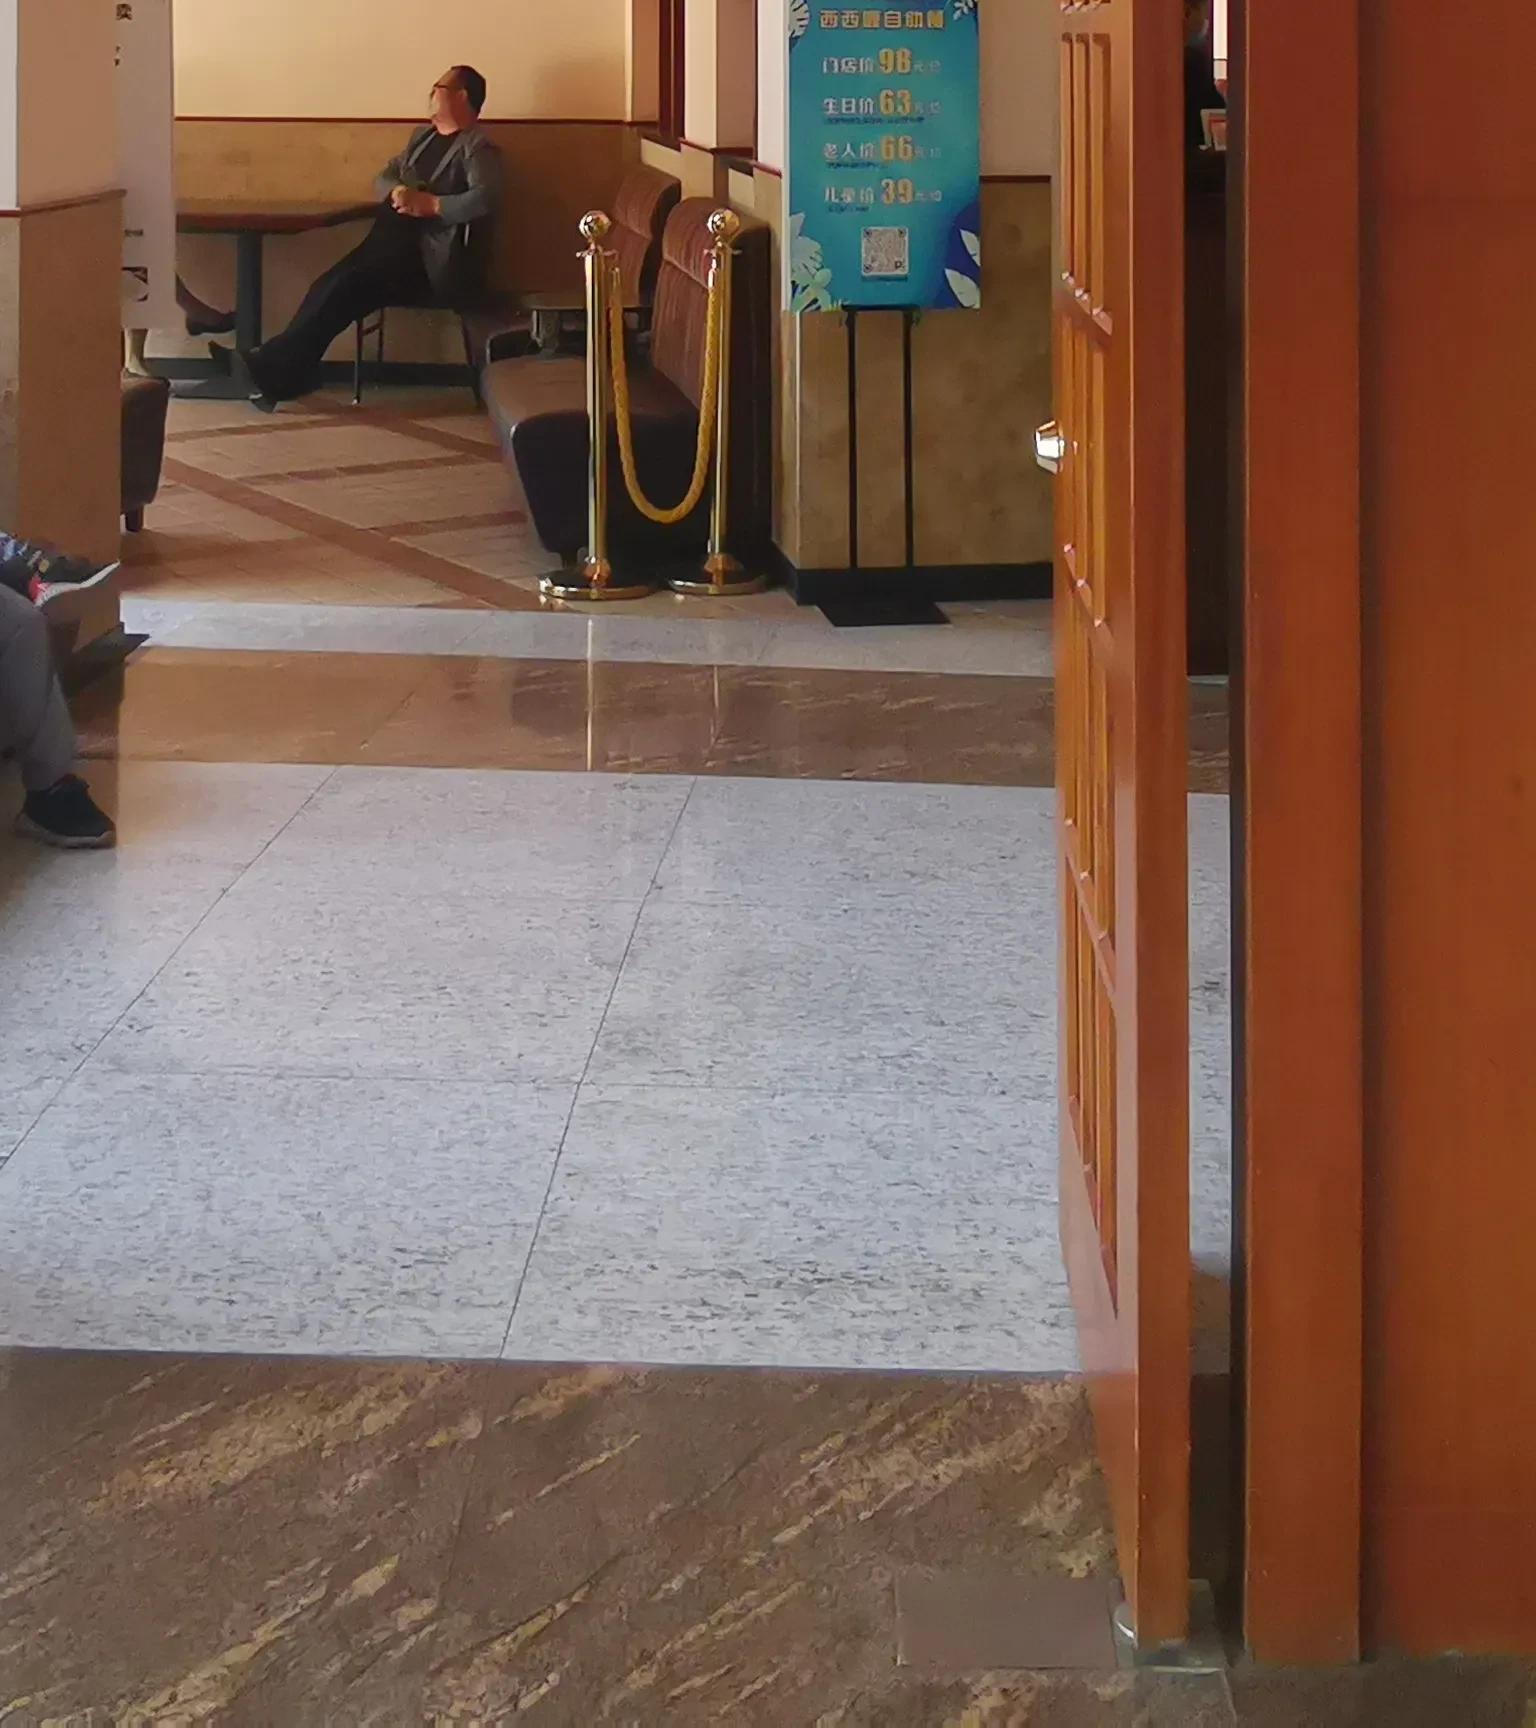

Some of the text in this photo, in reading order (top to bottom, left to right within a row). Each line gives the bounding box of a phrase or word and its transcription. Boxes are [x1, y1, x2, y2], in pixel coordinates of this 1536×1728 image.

[879, 88, 912, 116] 63
[880, 135, 913, 162] 66
[881, 177, 914, 205] 39
